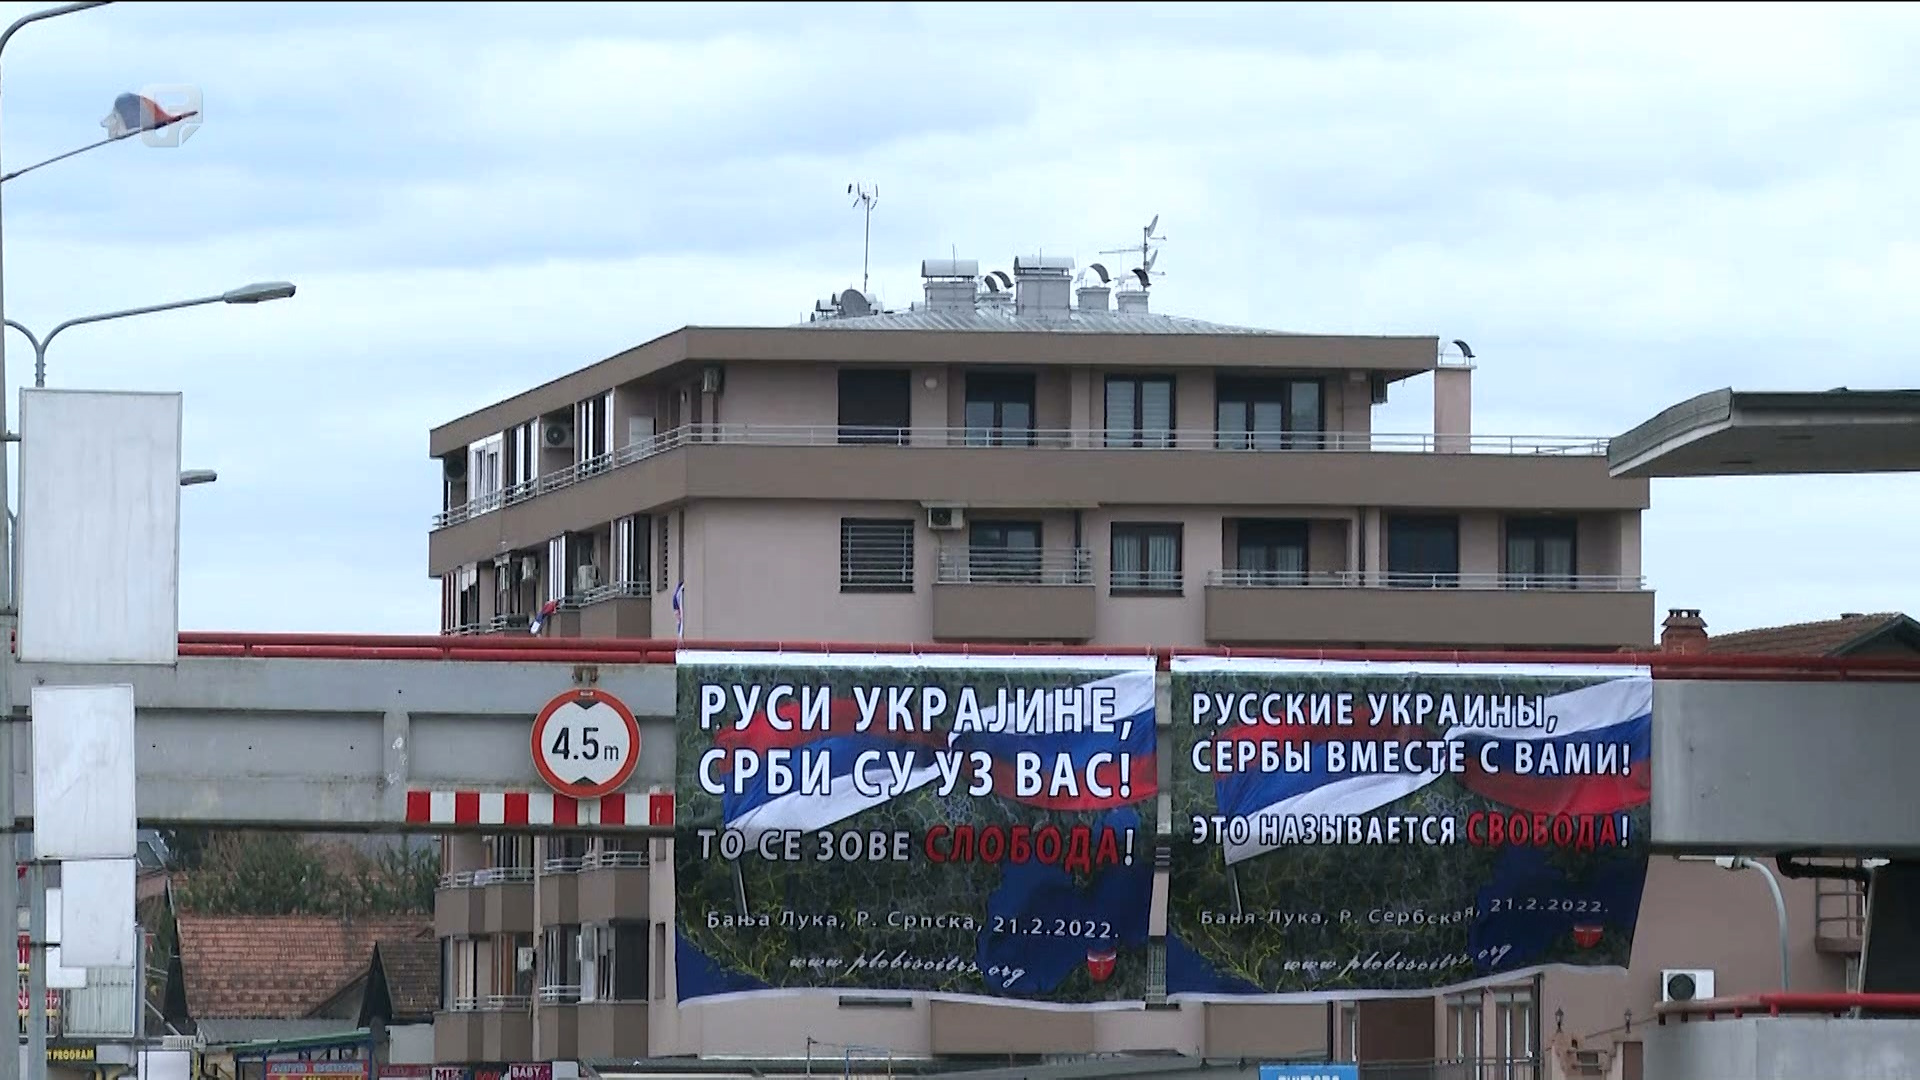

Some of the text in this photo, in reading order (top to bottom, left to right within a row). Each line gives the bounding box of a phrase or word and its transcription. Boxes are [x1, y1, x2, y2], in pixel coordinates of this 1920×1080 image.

[700, 684, 1133, 741] РУСИ УКРАЈИНЕ,
[1192, 693, 1558, 733] РУССКИЕ УКРАИНЫ,
[552, 727, 619, 761] 4.5 m
[1192, 740, 1632, 776] СЕРБЫ ВМЕСТЕ С ВАМИ!
[699, 748, 1132, 798] СРБИ СУ УЗ ВАС!
[698, 826, 1135, 873] ТО СЕ ЗОВЕ СЛОБОДА!
[1192, 812, 1630, 852] ЭТО НАЗЫВАЕТСЯ СВОБОДА!
[707, 911, 1119, 938] Бања Лука, Р. Српска, 21.2.2022.
[1340, 909, 1358, 924] Р.
[1368, 906, 1480, 925] Сербская,
[1490, 898, 1608, 912] 21.2.2022.
